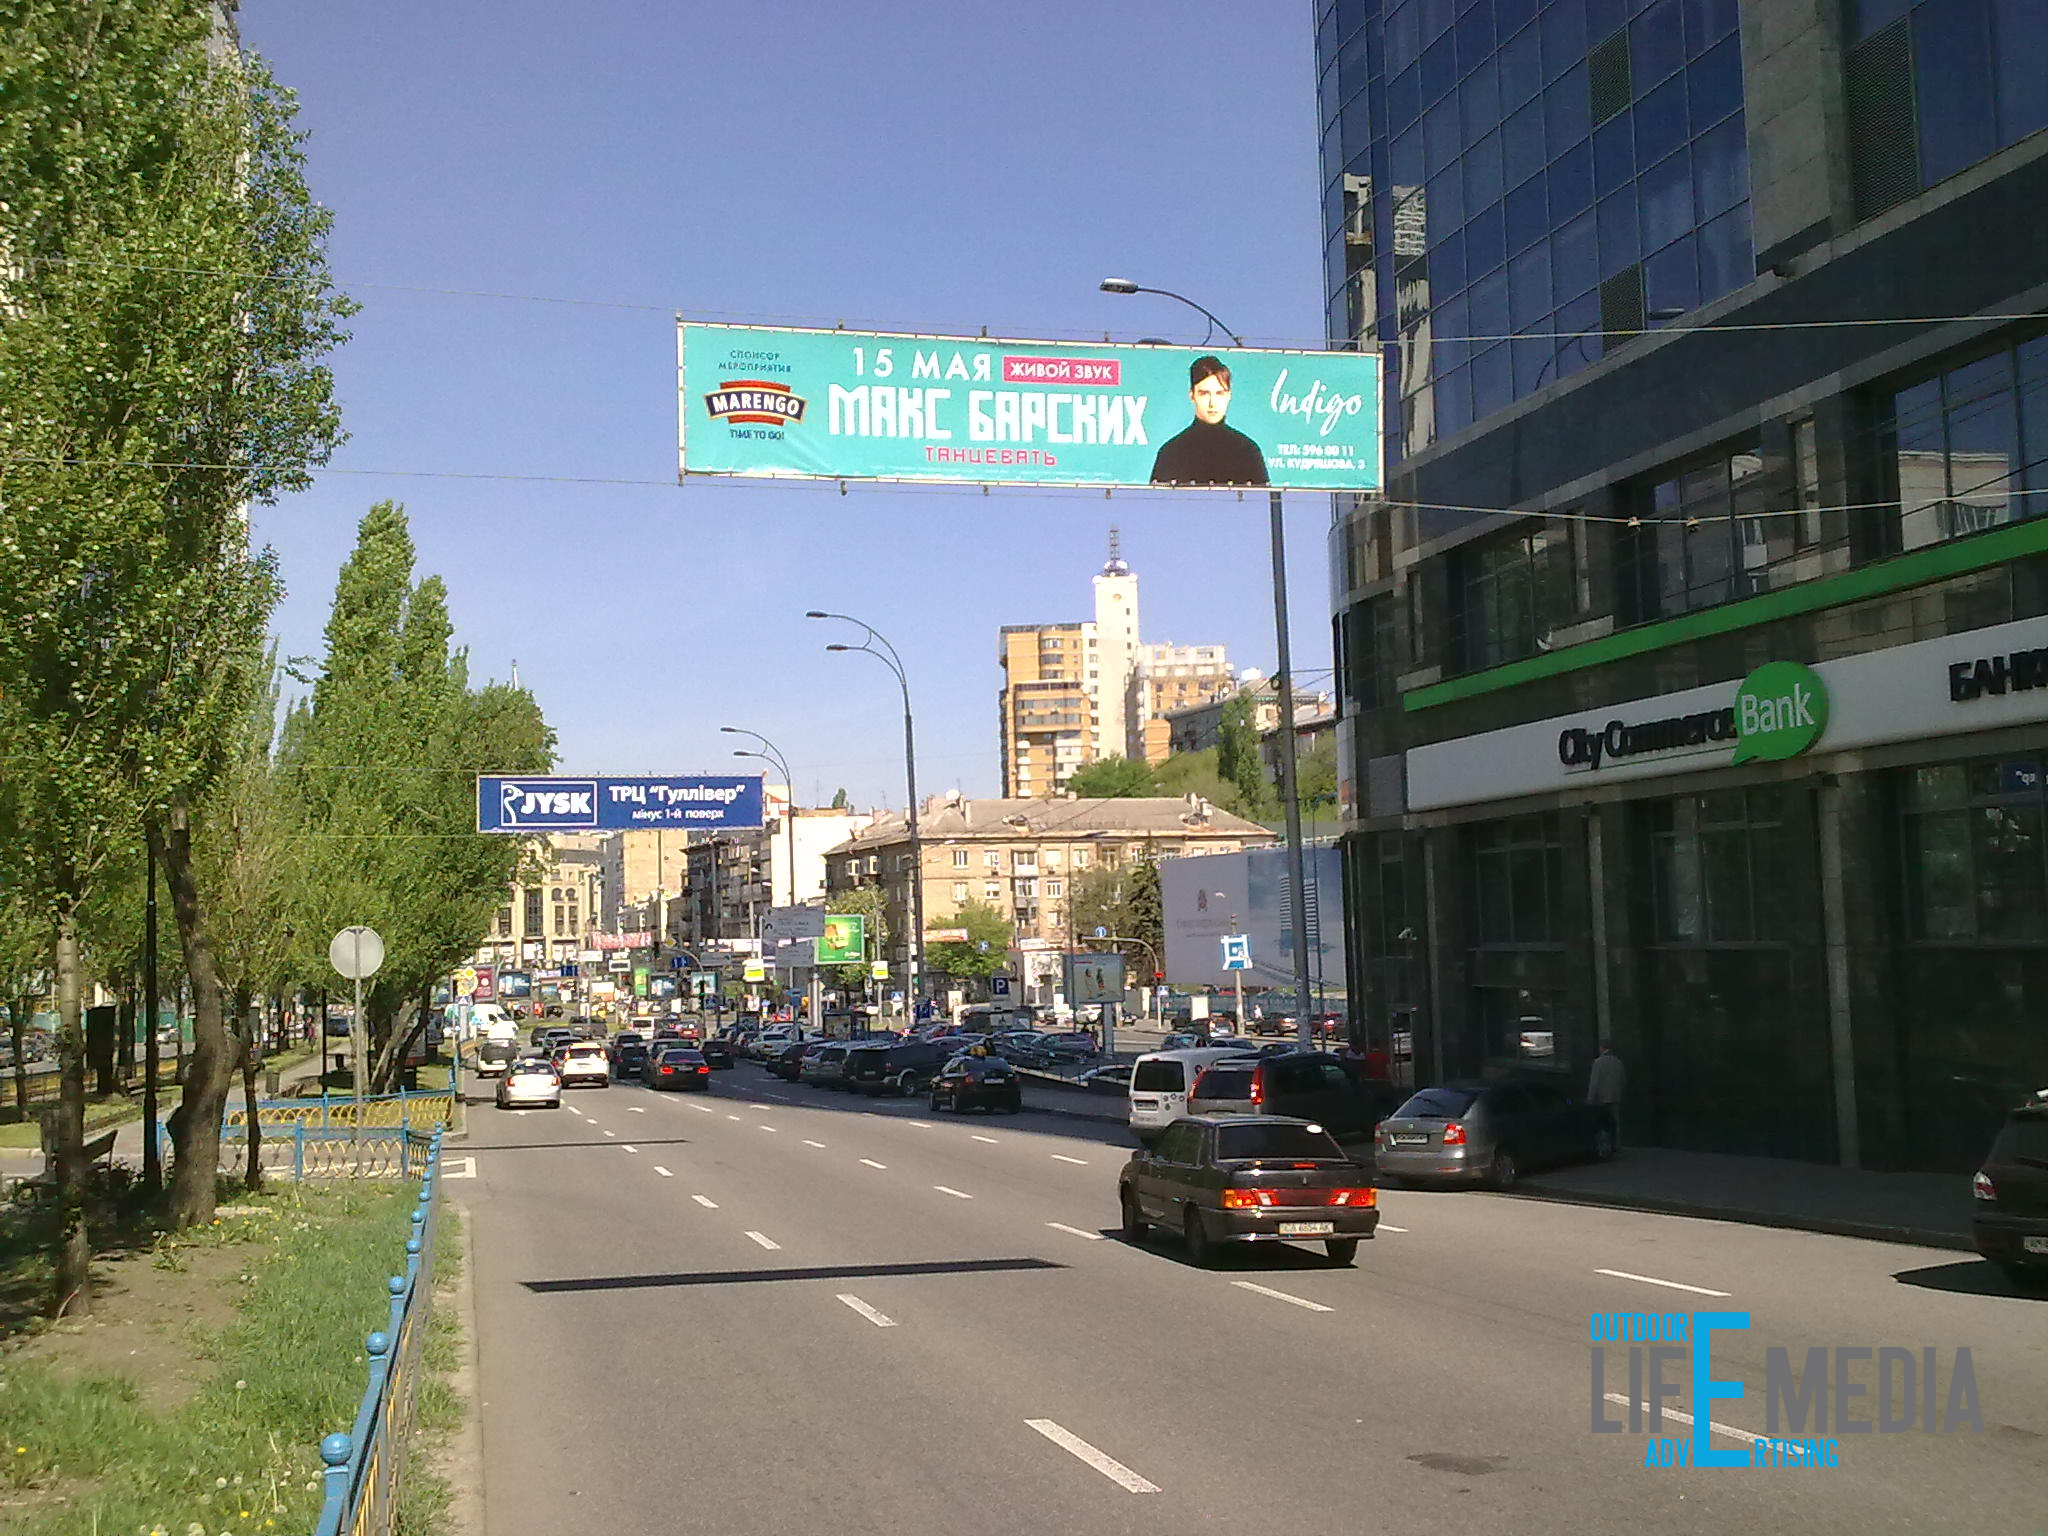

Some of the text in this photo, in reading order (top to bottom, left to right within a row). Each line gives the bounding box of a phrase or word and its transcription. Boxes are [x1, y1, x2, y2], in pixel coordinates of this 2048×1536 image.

[730, 350, 780, 361] СПОНСОР
[853, 346, 991, 381] 15 МАЯ
[1010, 360, 1112, 379] ЖИВОЙ ЗВУК
[712, 393, 800, 415] MARENGO
[1270, 368, 1362, 437] Indigo
[828, 383, 1148, 446] МАКС БАРСКИХ
[730, 429, 785, 440] TIME TO GO!
[925, 447, 1057, 466] ТАНЦЕВАТЬ
[1342, 445, 1354, 457] 11
[1741, 683, 1815, 736] Bank
[520, 793, 591, 815] JYSK
[609, 785, 646, 805] ТРЦ
[632, 809, 662, 821] мінус
[685, 809, 724, 820] поверх
